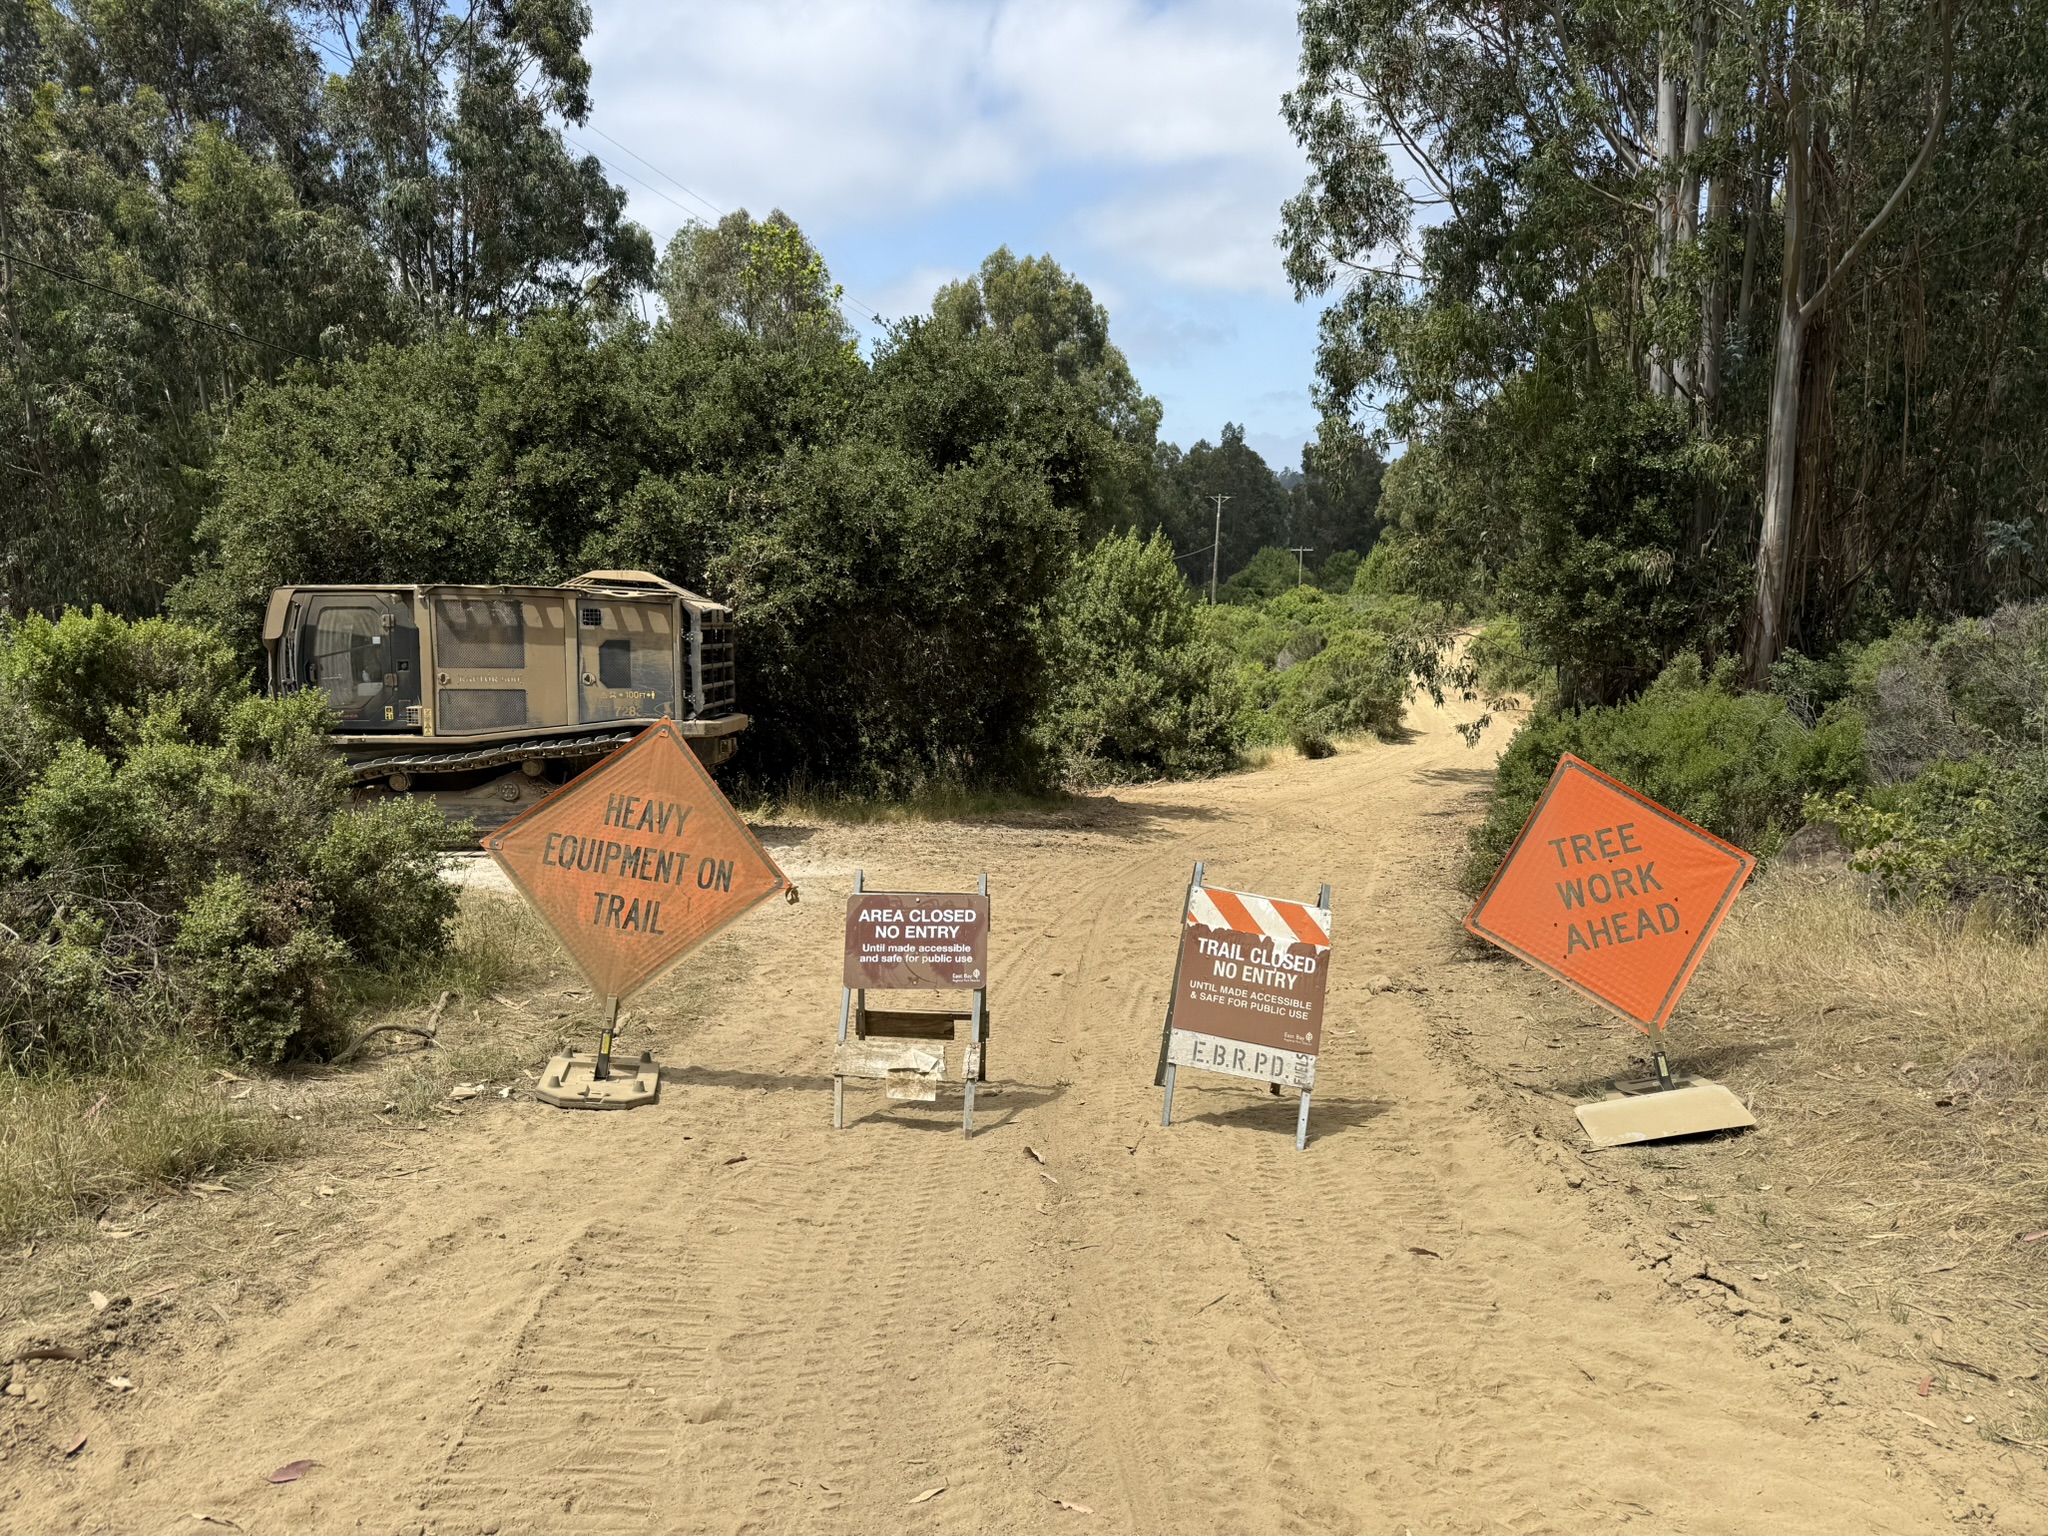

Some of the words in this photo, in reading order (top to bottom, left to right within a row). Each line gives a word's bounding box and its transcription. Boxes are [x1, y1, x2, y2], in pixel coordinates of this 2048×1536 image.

[604, 793, 693, 837] HEAVY
[1548, 822, 1643, 868] TREE
[542, 832, 690, 886] EQUIPMENT
[697, 857, 734, 893] ON
[1555, 861, 1664, 911] WORK
[593, 891, 664, 935] TRAIL
[858, 909, 904, 922] AREA
[909, 909, 977, 922] CLOSED
[1567, 903, 1680, 954] AHEAD
[862, 943, 885, 952] Until
[887, 943, 916, 952] made
[918, 943, 971, 952] accessible
[875, 925, 900, 939] NO
[905, 925, 960, 939] ENTRY
[859, 954, 878, 963] and
[881, 954, 902, 963] safe
[905, 954, 920, 963] for
[921, 954, 952, 964] public
[954, 955, 973, 963] use
[1198, 937, 1244, 961] TRAIL
[1250, 947, 1316, 974] CLOSED
[1213, 960, 1238, 979] NO
[1242, 965, 1298, 990] ENTRY
[1189, 979, 1217, 993] UNTIL
[1219, 985, 1248, 998] MADE
[1250, 992, 1313, 1010] ACCESSIBLE
[1190, 990, 1197, 999] &
[1199, 992, 1225, 1004] SAFE
[1227, 997, 1248, 1009] FOR
[1250, 1001, 1286, 1016] PUBLIC
[1288, 1009, 1309, 1020] USE
[1293, 1053, 1309, 1086] FUELS
